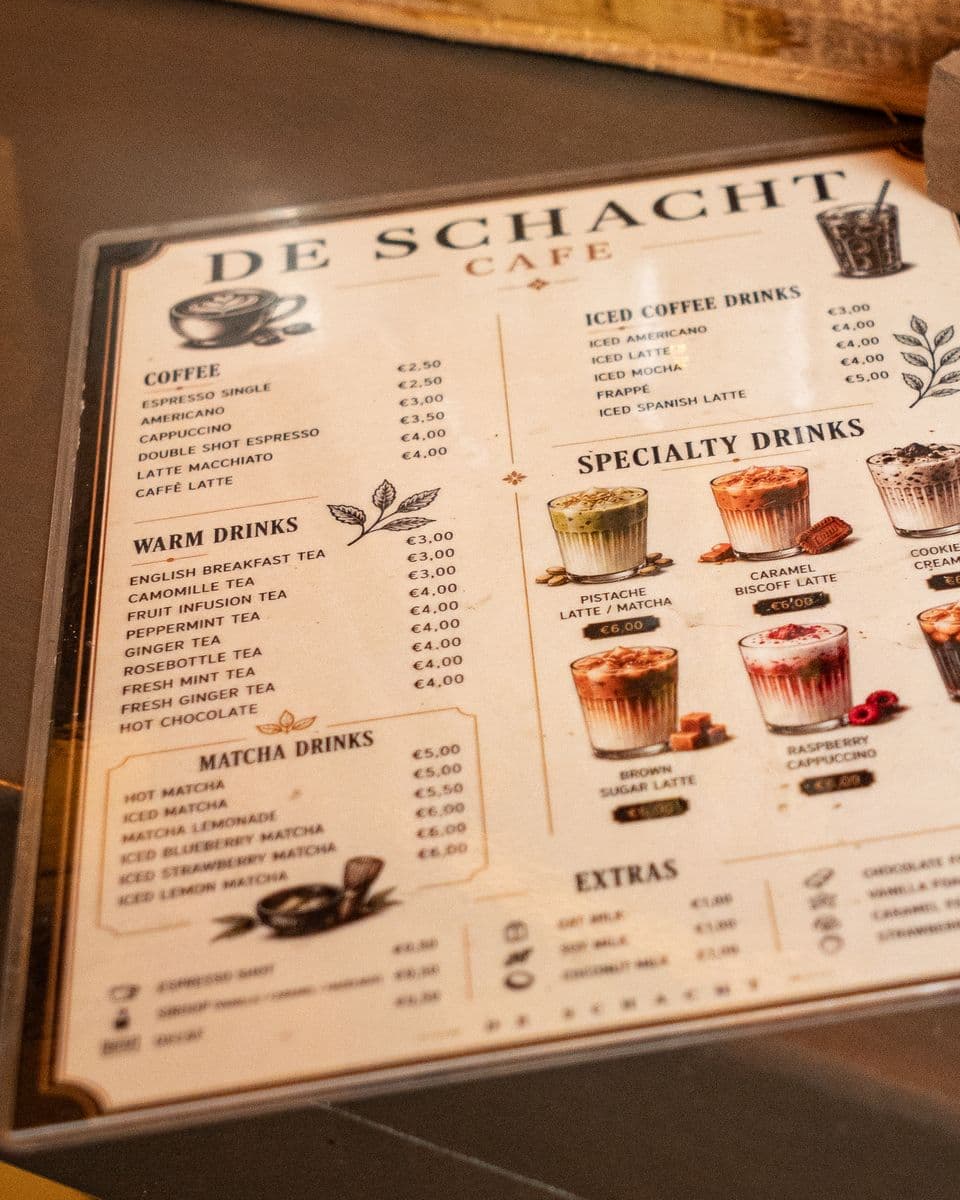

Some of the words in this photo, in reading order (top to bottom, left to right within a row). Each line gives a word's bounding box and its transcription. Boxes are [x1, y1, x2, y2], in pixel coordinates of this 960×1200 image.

[206, 238, 329, 284] DE
[375, 170, 847, 263] SCHACHT
[464, 241, 613, 278] CAFE
[585, 308, 632, 327] ICED
[641, 296, 717, 319] COFFEE
[725, 285, 802, 308] DRINKS
[589, 336, 620, 348] ICED
[626, 325, 707, 343] AMERICANO
[592, 353, 623, 365] ICED
[629, 346, 671, 359] LATTE
[144, 363, 220, 386] COFFEE
[594, 370, 625, 382] ICED
[631, 363, 683, 377] MOCHA
[142, 390, 215, 409] ESPRESSO
[221, 383, 271, 398] SINGLE
[599, 405, 631, 418] ICED
[637, 395, 698, 413] SPANISH
[703, 389, 747, 402] LATTE
[141, 406, 225, 426] AMERICANO
[138, 445, 196, 462] DOUBLE
[202, 439, 239, 454] SHOT
[246, 428, 319, 447] ESPRESSO
[139, 423, 231, 444] CAPPUCCINO
[578, 435, 738, 475] SPECIALTY
[750, 418, 865, 451] DRINKS
[136, 465, 182, 480] LATTE
[188, 452, 273, 472] MACCHIATO
[188, 476, 233, 491] LATTE
[133, 530, 203, 555] WARM
[213, 516, 299, 543] DRINKS
[129, 568, 196, 586] ENGLISH
[203, 554, 291, 575] BREAKFAST
[297, 549, 326, 561] TEA
[750, 564, 816, 581] CARAMEL
[128, 582, 219, 604] CAMOMILLE
[225, 577, 255, 589] TEA
[580, 587, 647, 604] PISTACHE
[735, 580, 792, 596] BISCOFF
[797, 573, 838, 588] LATTE
[127, 606, 172, 622] FRUIT
[179, 594, 252, 614] INFUSION
[258, 590, 287, 601] TEA
[559, 607, 601, 620] LATTE
[616, 596, 673, 613] MATCHA
[126, 616, 224, 640] PEPPERMINT
[231, 611, 260, 623] TEA
[125, 640, 184, 658] GINGER
[191, 635, 221, 648] TEA
[124, 652, 226, 676] ROSEBOTTLE
[233, 647, 262, 660] TEA
[122, 679, 173, 696] FRESH
[180, 671, 219, 686] MINT
[226, 667, 256, 679] TEA
[121, 698, 173, 715] FRESH
[179, 688, 239, 705] GINGER
[246, 683, 275, 695] TEA
[120, 720, 154, 734] HOT
[161, 704, 258, 727] CHOCOLATE
[199, 743, 286, 772] MATCHA
[295, 730, 374, 757] DRINKS
[787, 735, 870, 756] RASPBERRY
[619, 765, 673, 781] BROWN
[786, 749, 877, 771] CAPPUCCINO
[124, 790, 154, 804] HOT
[161, 779, 225, 798] MATCHA
[600, 782, 648, 798] SUGAR
[653, 775, 697, 791] LATTE
[123, 809, 158, 824] ICED
[164, 799, 228, 817] MATCHA
[121, 825, 185, 843] MATCHA
[192, 810, 277, 833] LEMONADE
[120, 849, 156, 865] ICED
[162, 834, 255, 857] BLUEBERRY
[261, 823, 324, 843] MATCHA
[119, 869, 155, 885] ICED
[162, 852, 266, 878] STRAWBERRY
[272, 842, 337, 861] MATCHA
[575, 858, 679, 893] EXTRAS
[117, 889, 154, 906] ICED
[160, 881, 216, 900] LEMON
[223, 870, 289, 889] MATCHA
